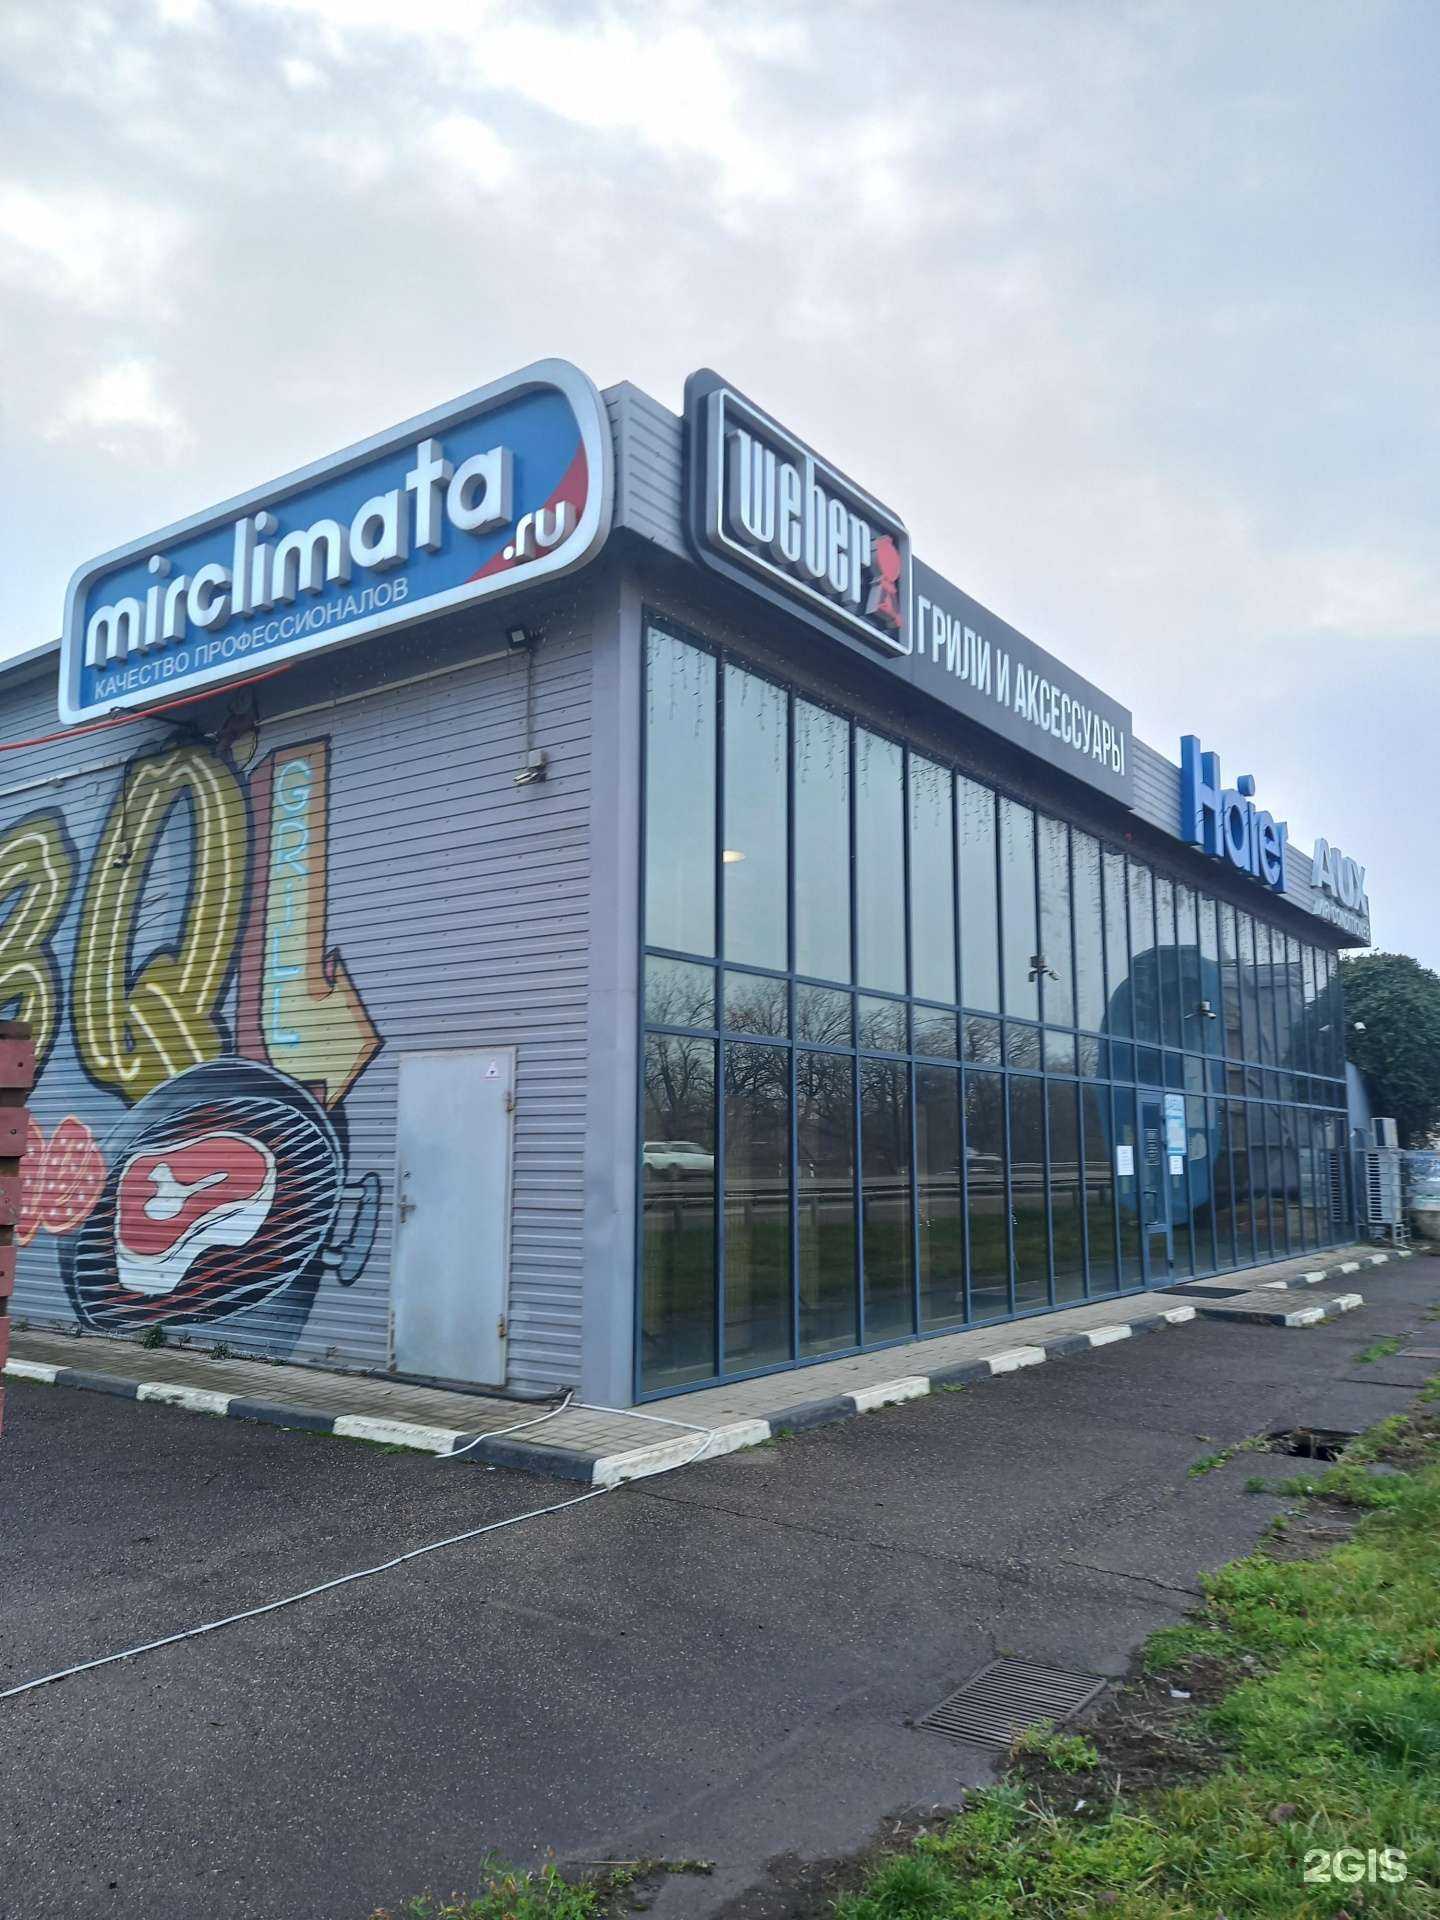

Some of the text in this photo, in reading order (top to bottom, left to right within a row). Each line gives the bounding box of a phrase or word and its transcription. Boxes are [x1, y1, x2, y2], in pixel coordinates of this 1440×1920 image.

[84, 437, 513, 669] mirclimata
[93, 576, 409, 702] КАЧЕСТВО ПРОФЕССИОНАЛОВ
[917, 594, 1126, 777] ГРИЛИ И АКСЕССУАРЫ
[271, 758, 313, 1045] GRILL
[1180, 734, 1289, 894] Haier
